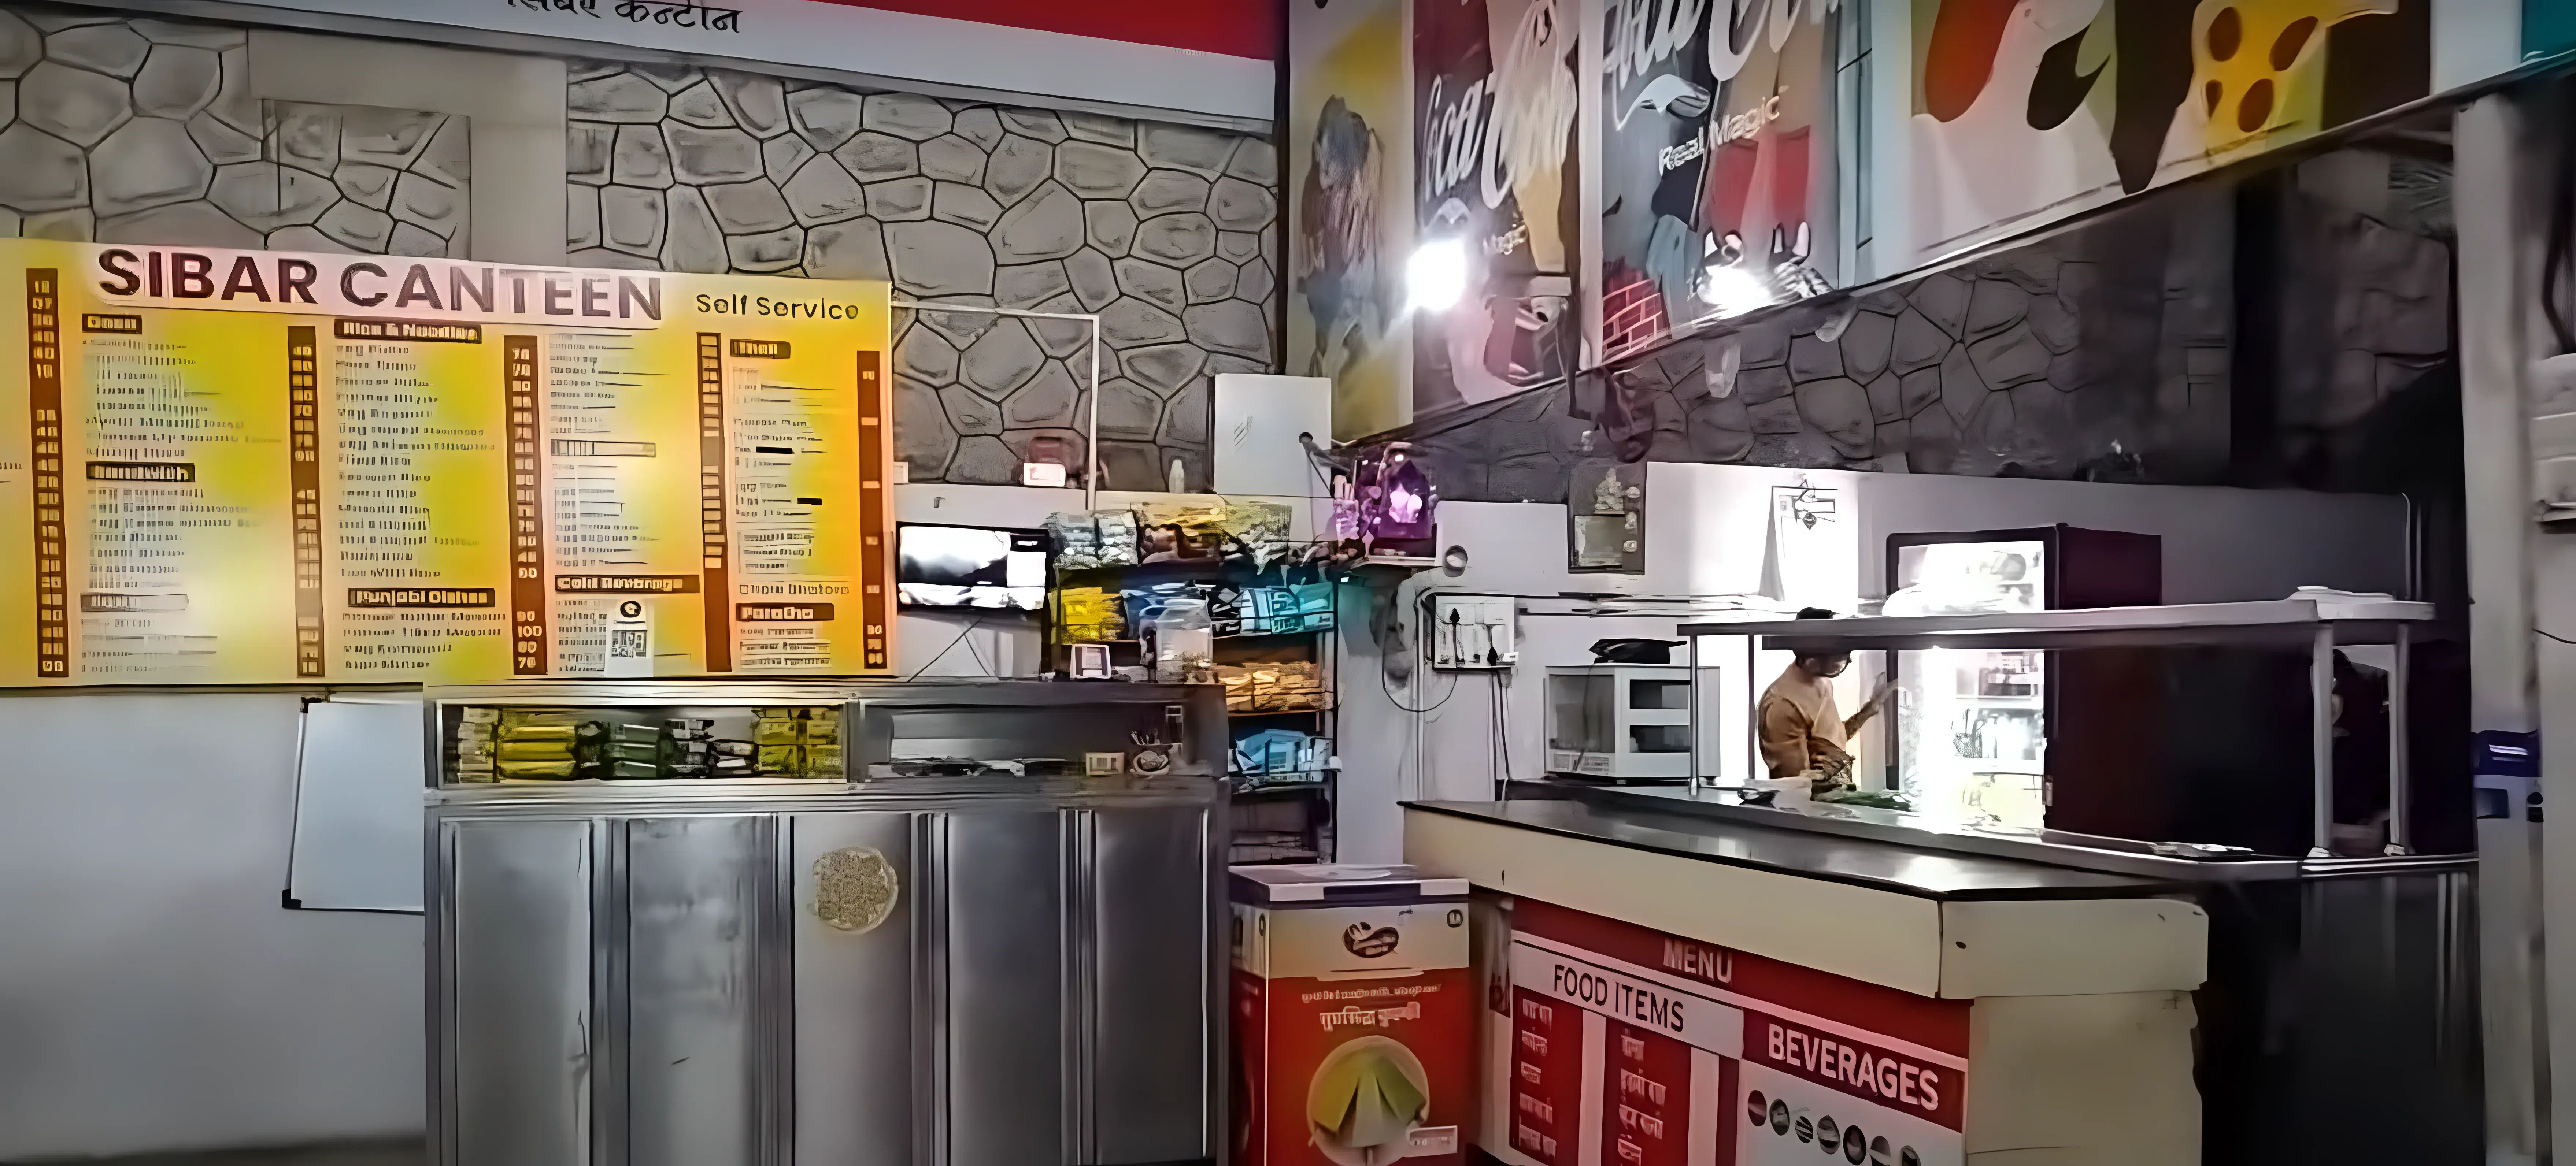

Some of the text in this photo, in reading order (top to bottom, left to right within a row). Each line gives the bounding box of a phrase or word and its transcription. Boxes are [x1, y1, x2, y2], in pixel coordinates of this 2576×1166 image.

[97, 248, 662, 321] SIBAR CANTEEN
[1663, 937, 1733, 984] MENU
[1553, 964, 1685, 1033] FOOD ITEMS
[1768, 1023, 1939, 1111] BEVERAGES
